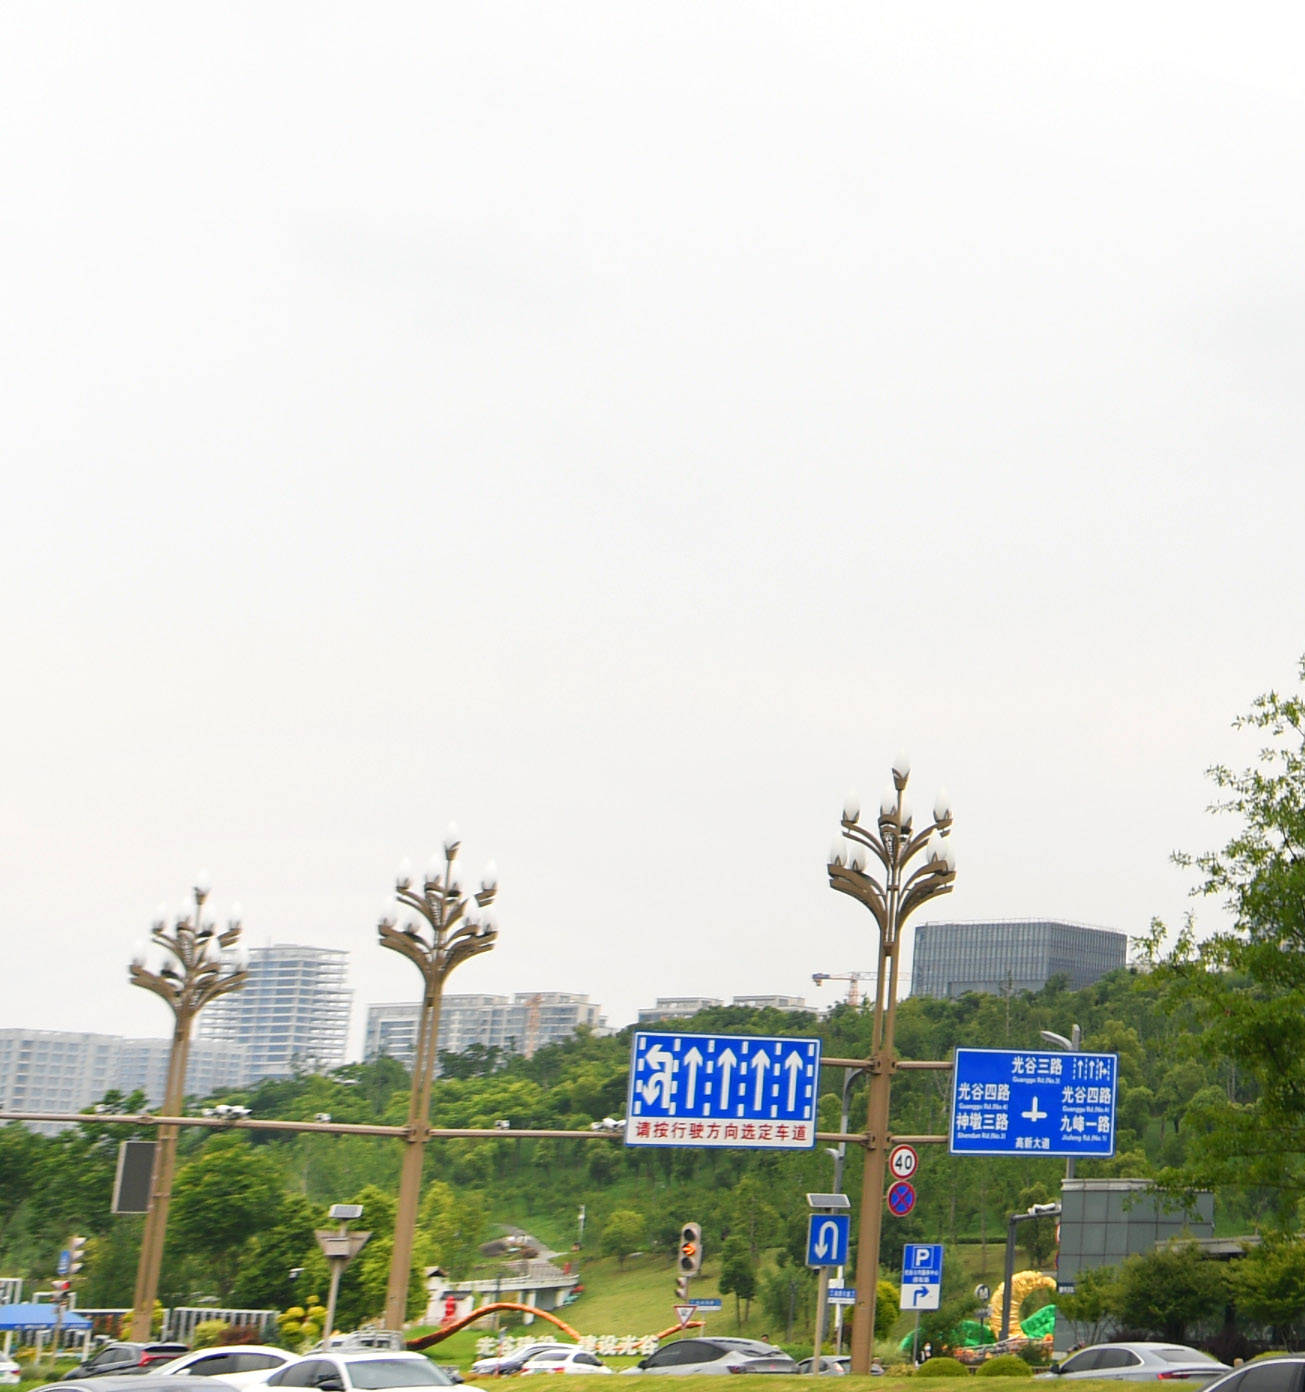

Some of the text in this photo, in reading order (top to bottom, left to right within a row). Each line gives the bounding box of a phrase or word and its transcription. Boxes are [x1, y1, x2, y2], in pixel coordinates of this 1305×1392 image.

[1011, 1056, 1063, 1075] 光谷三路
[958, 1082, 1010, 1101] 光谷四路
[1062, 1086, 1111, 1104] 光谷四路
[636, 1121, 808, 1141] 请按行驶方向选定车道
[956, 1112, 1009, 1131] 神墩三路
[1060, 1114, 1110, 1133] 九峰一路
[1015, 1136, 1050, 1149] 高新大道
[895, 1154, 913, 1170] 40
[915, 1248, 930, 1267] P
